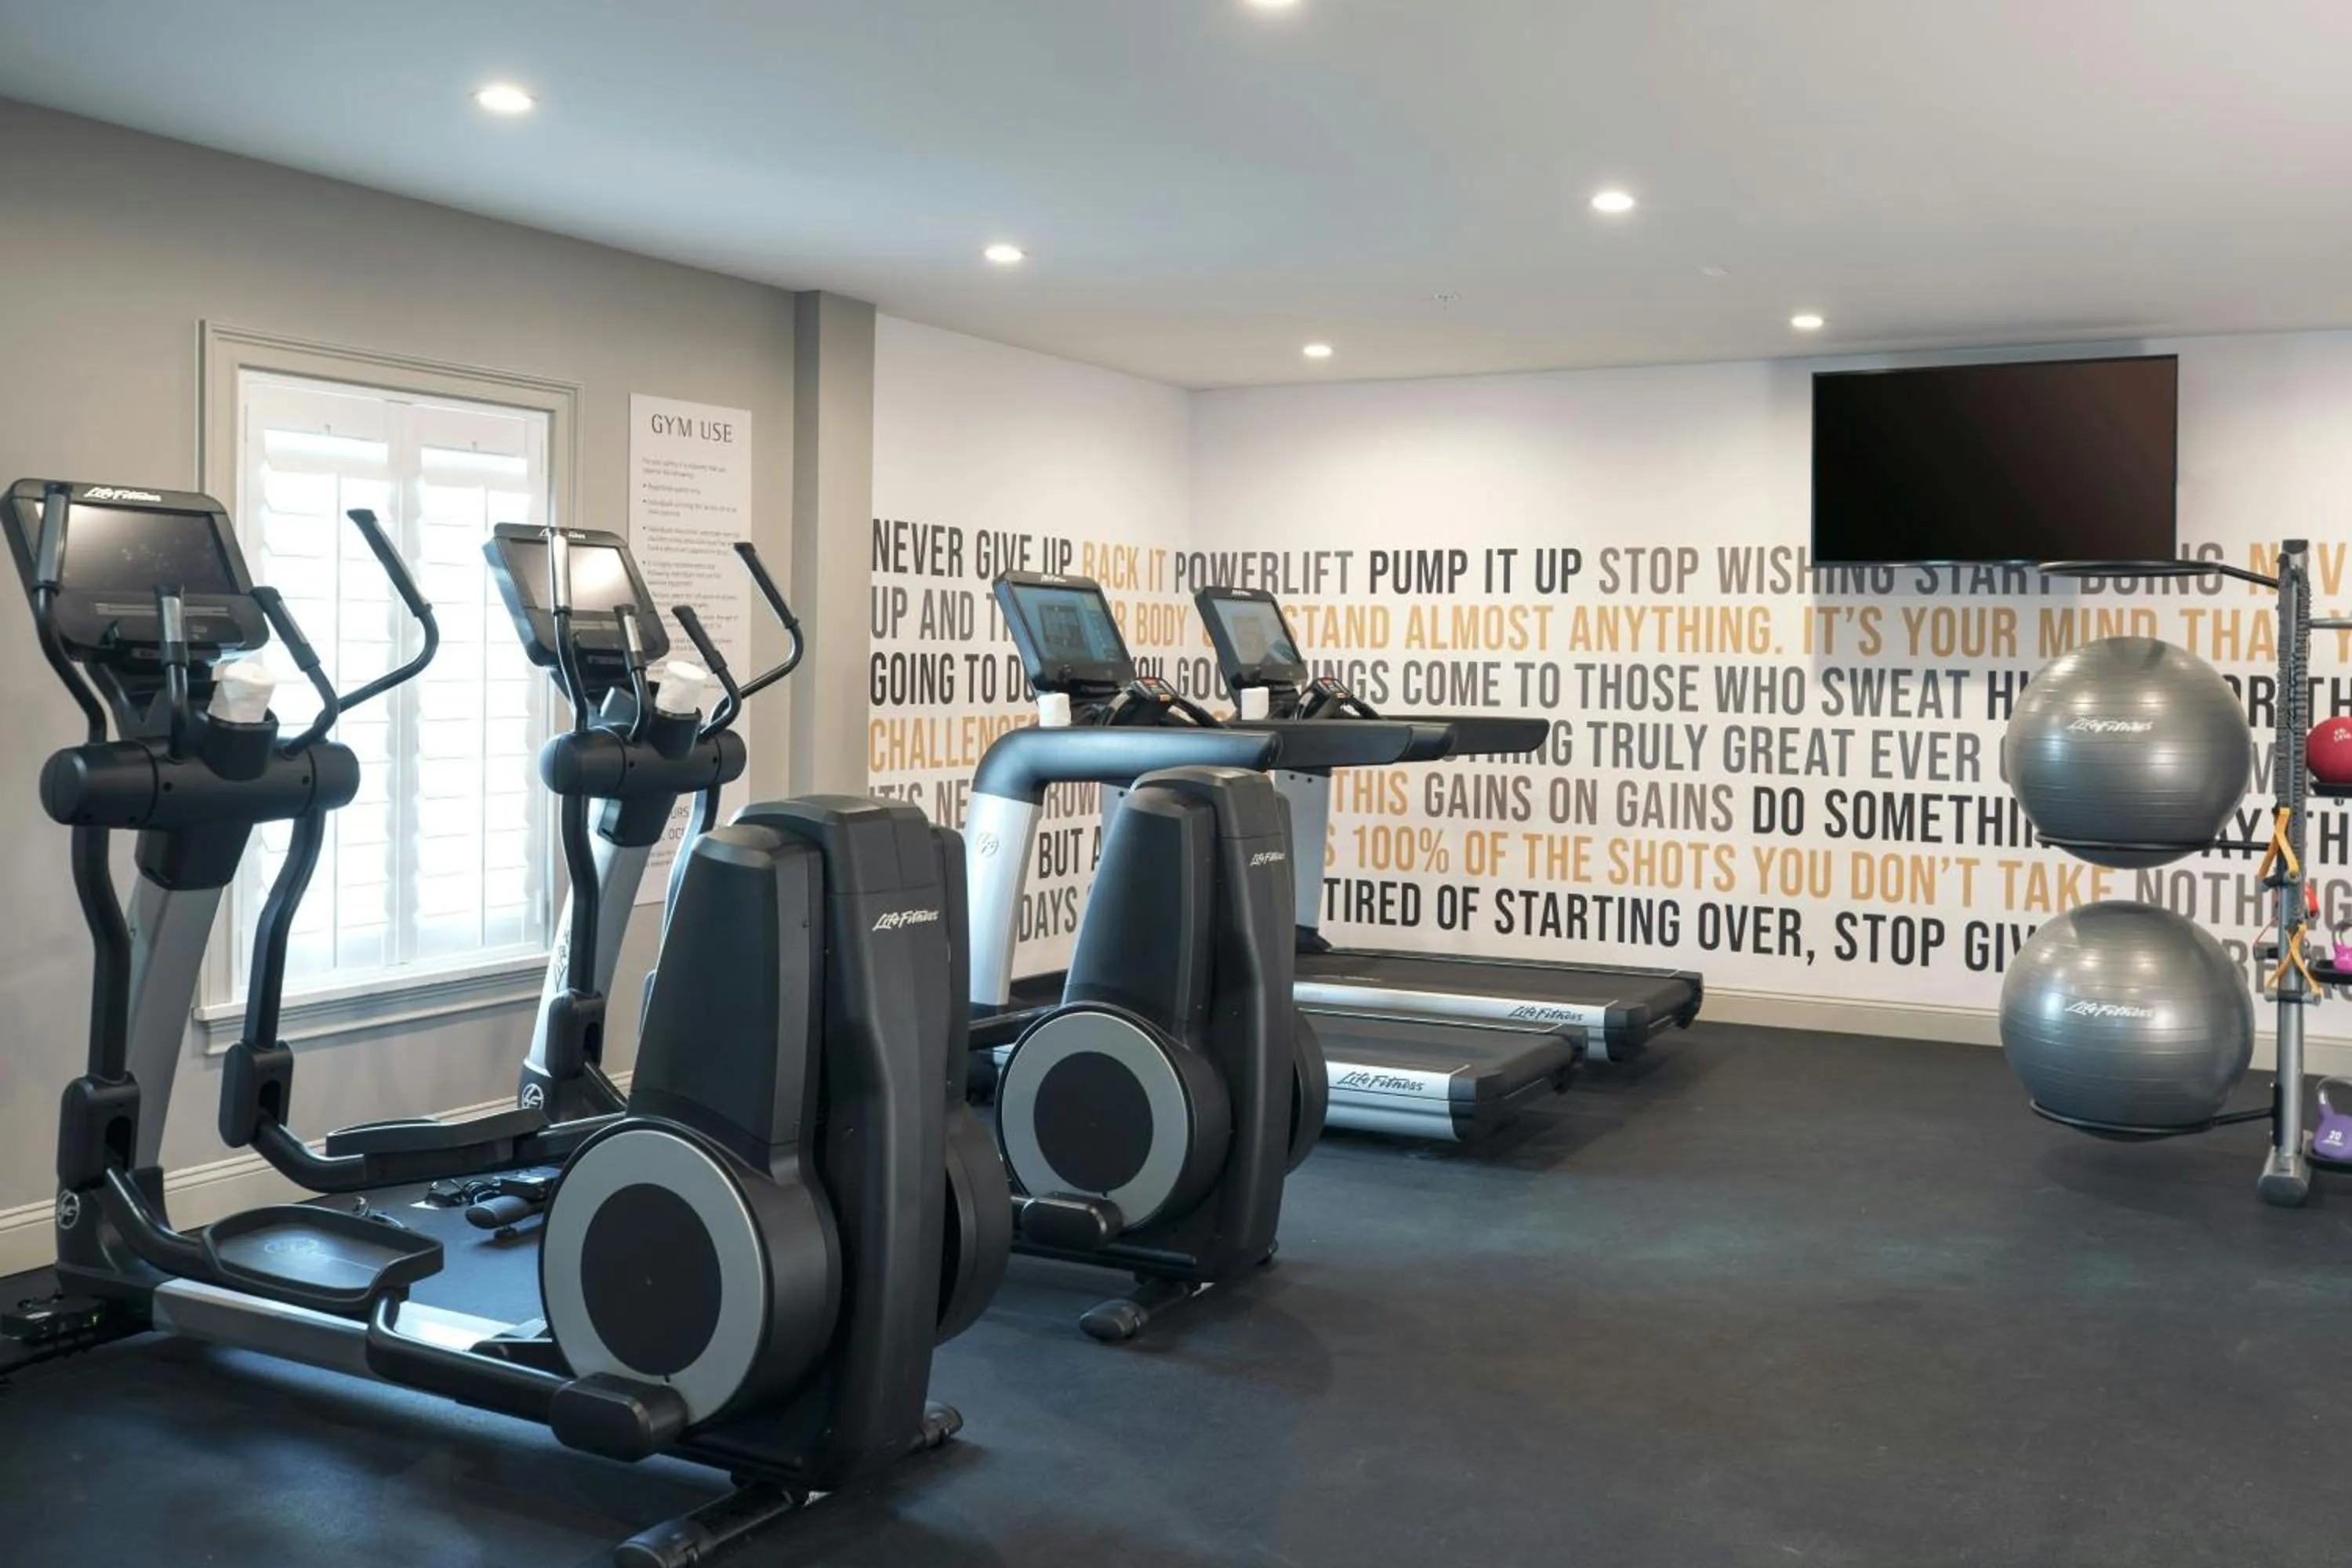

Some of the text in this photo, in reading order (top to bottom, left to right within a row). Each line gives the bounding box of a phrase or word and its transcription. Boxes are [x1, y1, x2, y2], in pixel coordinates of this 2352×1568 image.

[652, 414, 732, 443] GYM USE
[873, 519, 963, 577] NEVER
[976, 530, 1032, 579] GIVE
[1043, 537, 1072, 575] UP
[1149, 549, 1166, 592] IT
[1176, 551, 1353, 594] POWERLIFT
[1370, 550, 1468, 594] PUMP
[1485, 548, 1518, 593] IT
[1535, 548, 1581, 593] UP
[1599, 546, 1699, 594] STOP
[872, 586, 907, 639] UP
[919, 589, 974, 641] AND
[1136, 602, 1188, 647] BODY
[1405, 604, 1553, 651] ALMOST
[1569, 605, 1783, 654] ANYTHING.
[1804, 606, 1882, 656] IT'S
[1902, 607, 2017, 657] YOUR
[2040, 608, 2158, 658] MIND
[2180, 608, 2275, 661] THA
[870, 652, 954, 706] GOING
[964, 653, 996, 704] TO
[1403, 661, 1501, 706] COME
[1515, 662, 1560, 709] TO
[1574, 663, 1699, 712] THOSE
[1715, 665, 1804, 716] WHO
[1821, 667, 1969, 720] SWEAT
[1587, 720, 1708, 771] TRULY
[1723, 724, 1855, 777] GREAT
[1871, 730, 1980, 782] EVER
[1333, 770, 1408, 816] THIS
[1425, 772, 1531, 822] GAINS
[1548, 776, 1597, 825] ON
[1616, 779, 1733, 832] GAINS
[1753, 786, 1804, 836] DO
[1824, 789, 2049, 848] SOMETHI
[1039, 828, 1083, 879] BUT
[1353, 825, 1450, 874] 100%
[1465, 830, 1508, 877] OF
[1523, 833, 1592, 883] THE
[1608, 838, 1736, 892] SHOTS
[1753, 846, 1831, 898] YOU
[1851, 851, 1980, 908] DON'T
[1998, 859, 2115, 914] TAKE
[1018, 886, 1077, 942] DAYS
[1323, 877, 1421, 927] TIRED
[1437, 884, 1479, 931] OF
[1494, 887, 1680, 947] STARTING
[1697, 902, 1815, 966] OVER,
[1835, 912, 1944, 967] STOP
[1337, 1071, 1425, 1091] Life Fitness
